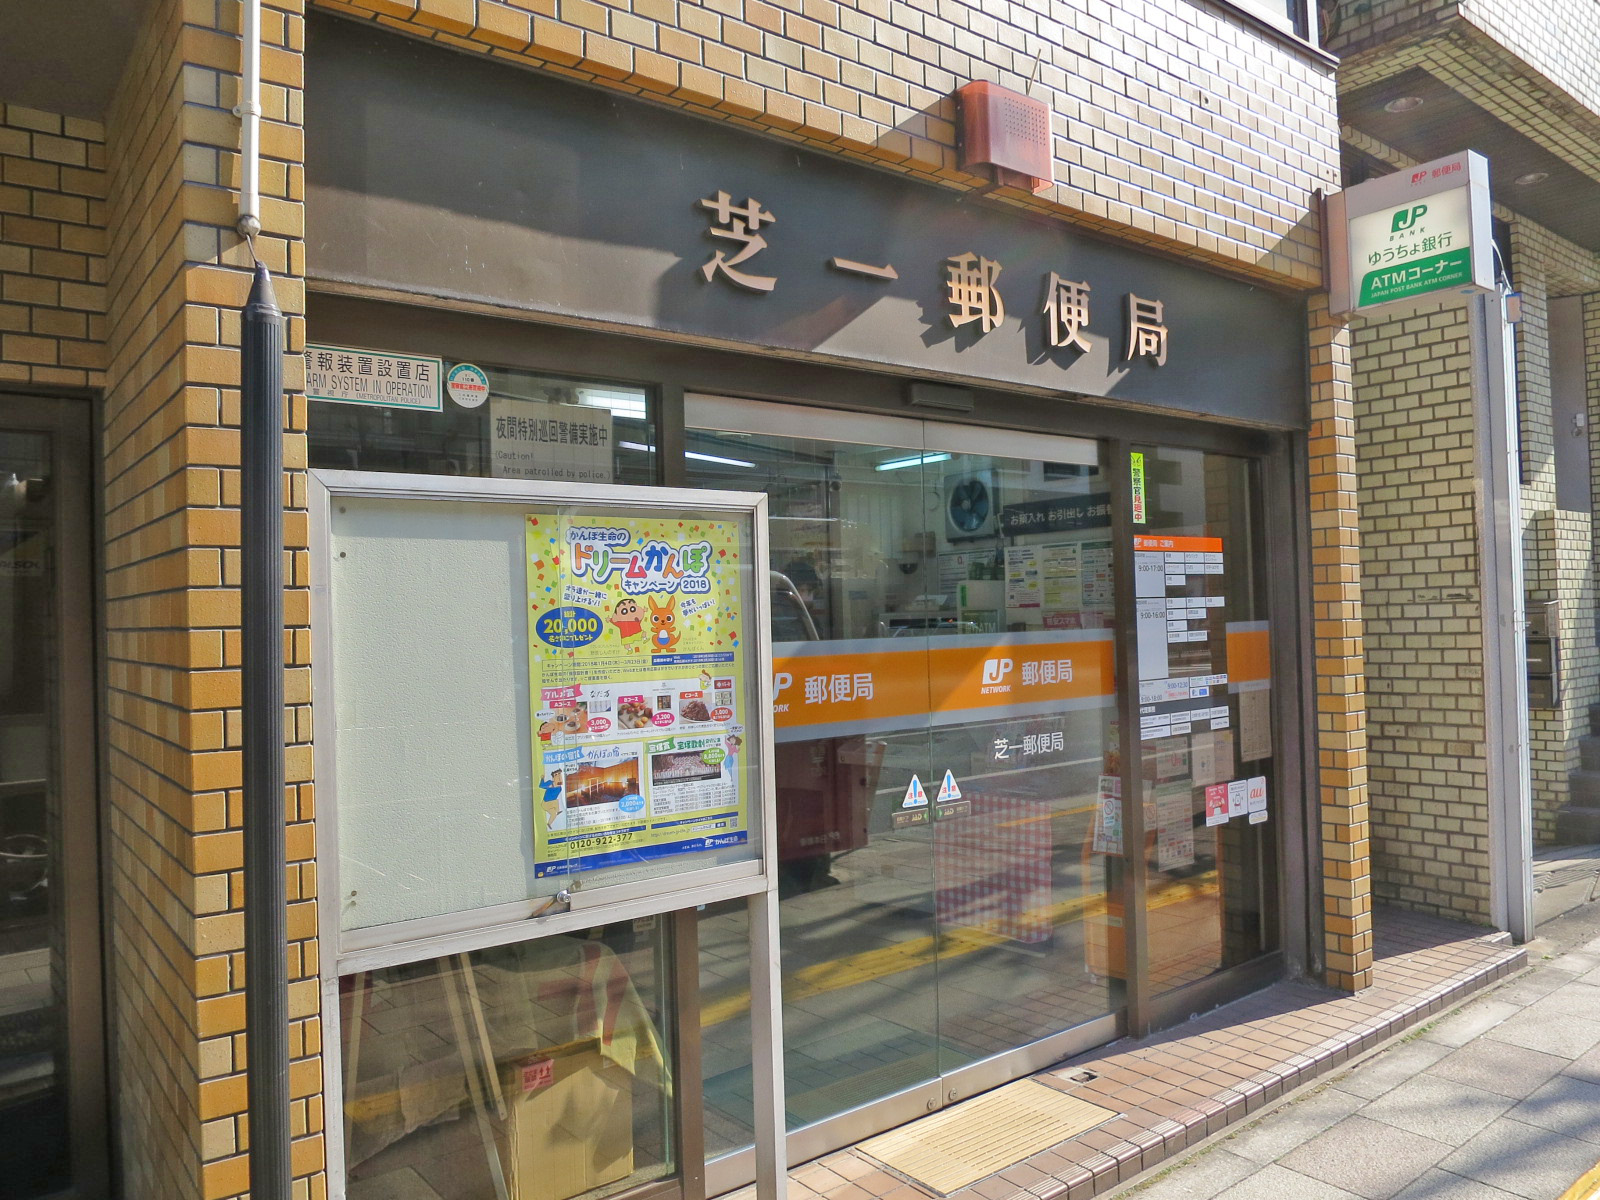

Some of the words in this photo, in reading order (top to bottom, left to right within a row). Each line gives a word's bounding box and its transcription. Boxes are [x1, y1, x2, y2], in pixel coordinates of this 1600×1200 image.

[1391, 204, 1428, 233] JP
[1389, 226, 1426, 242] BANK
[1368, 231, 1453, 266] ゆうちょ銀行
[700, 189, 1169, 367] 芝一郵便局
[1371, 259, 1462, 290] ATMコーナー
[1371, 289, 1389, 298] JAPAN
[1390, 285, 1404, 294] POST
[1405, 281, 1423, 290] BANK
[1424, 277, 1438, 286] ATM
[1438, 272, 1463, 283] CORNER
[331, 374, 368, 393] SYSTEM
[372, 380, 382, 394] IN
[385, 380, 432, 399] OPERATION
[356, 393, 399, 403] (METROPOLITAN
[496, 416, 608, 447] 夜間特別巡回警備実施中
[502, 465, 521, 474] Area
[524, 467, 563, 477] patrolled
[566, 468, 575, 478] by
[578, 469, 611, 480] police.)
[569, 530, 628, 542] かんぽ生命の
[575, 543, 708, 579] ドリームかんぽ
[624, 579, 675, 590] キャンペーン
[682, 579, 707, 589] 2018
[543, 618, 598, 634] 20,000
[982, 658, 1013, 684] JP
[1021, 659, 1073, 686] 郵便局
[804, 673, 874, 705] 郵便局
[981, 685, 1011, 695] NETWORK
[993, 732, 1064, 760] 芝一郵便局
[1250, 787, 1264, 798] au
[570, 833, 633, 850] 0120-922-377
